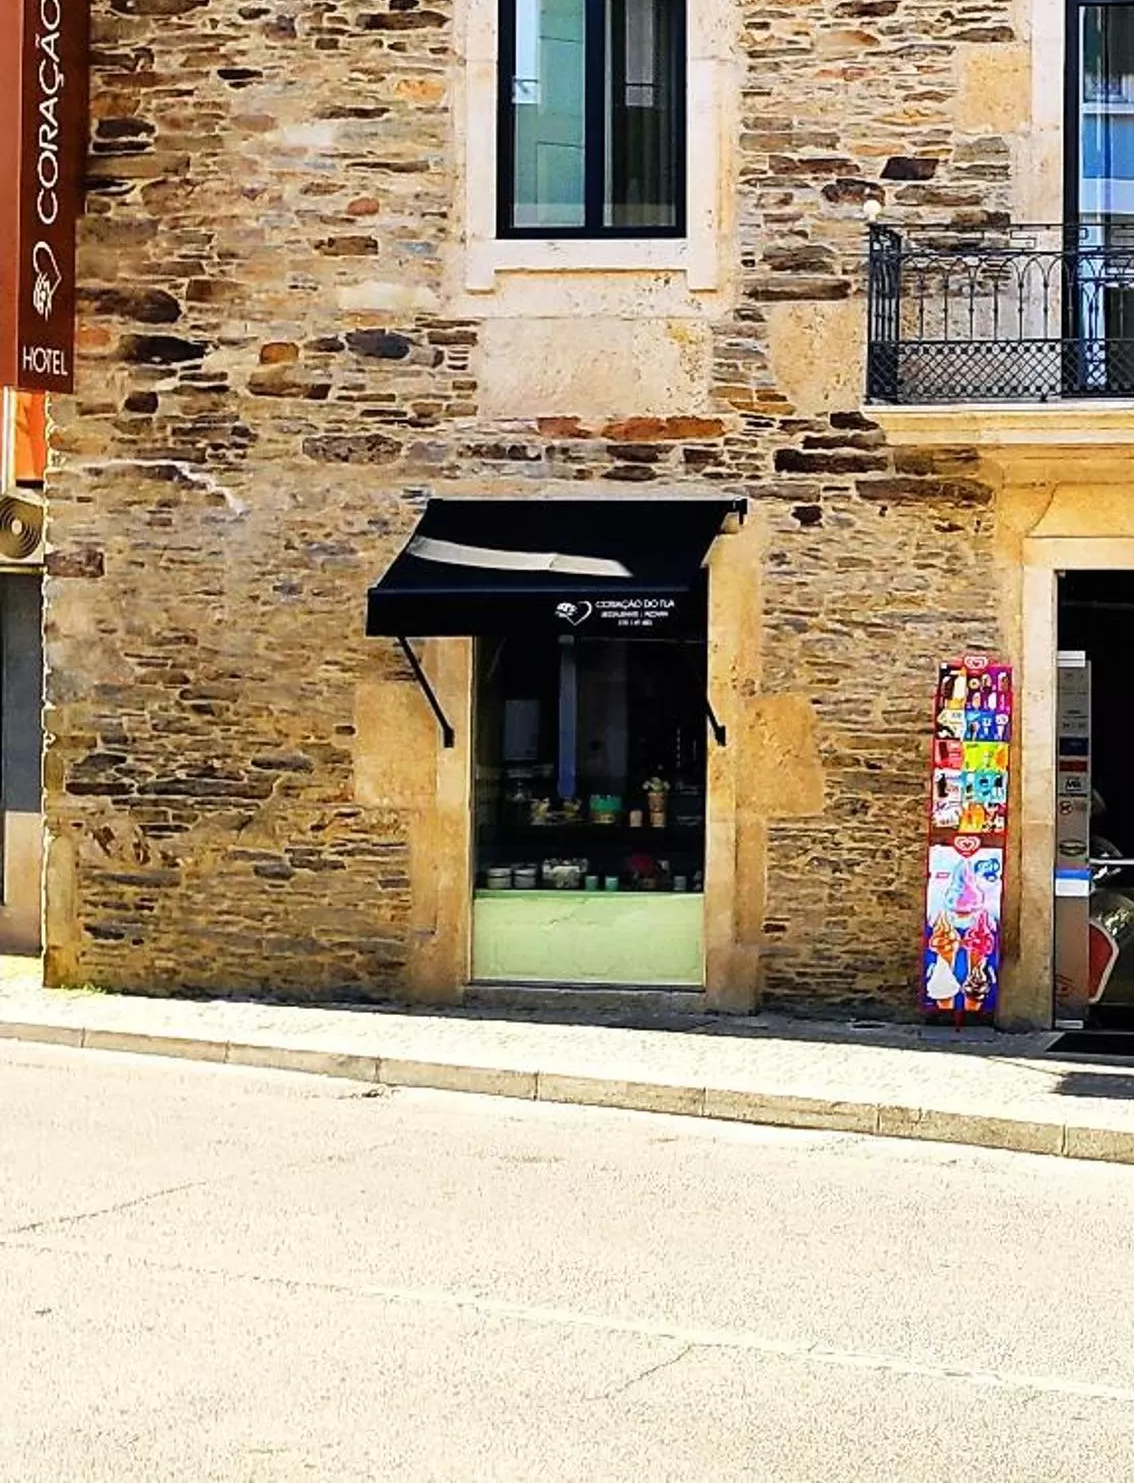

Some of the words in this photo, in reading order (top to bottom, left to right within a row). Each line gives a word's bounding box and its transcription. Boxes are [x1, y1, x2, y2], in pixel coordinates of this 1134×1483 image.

[22, 346, 69, 376] HOTEL
[595, 600, 642, 609] CORAÇÃO
[643, 599, 659, 608] DO
[660, 599, 675, 608] TUA
